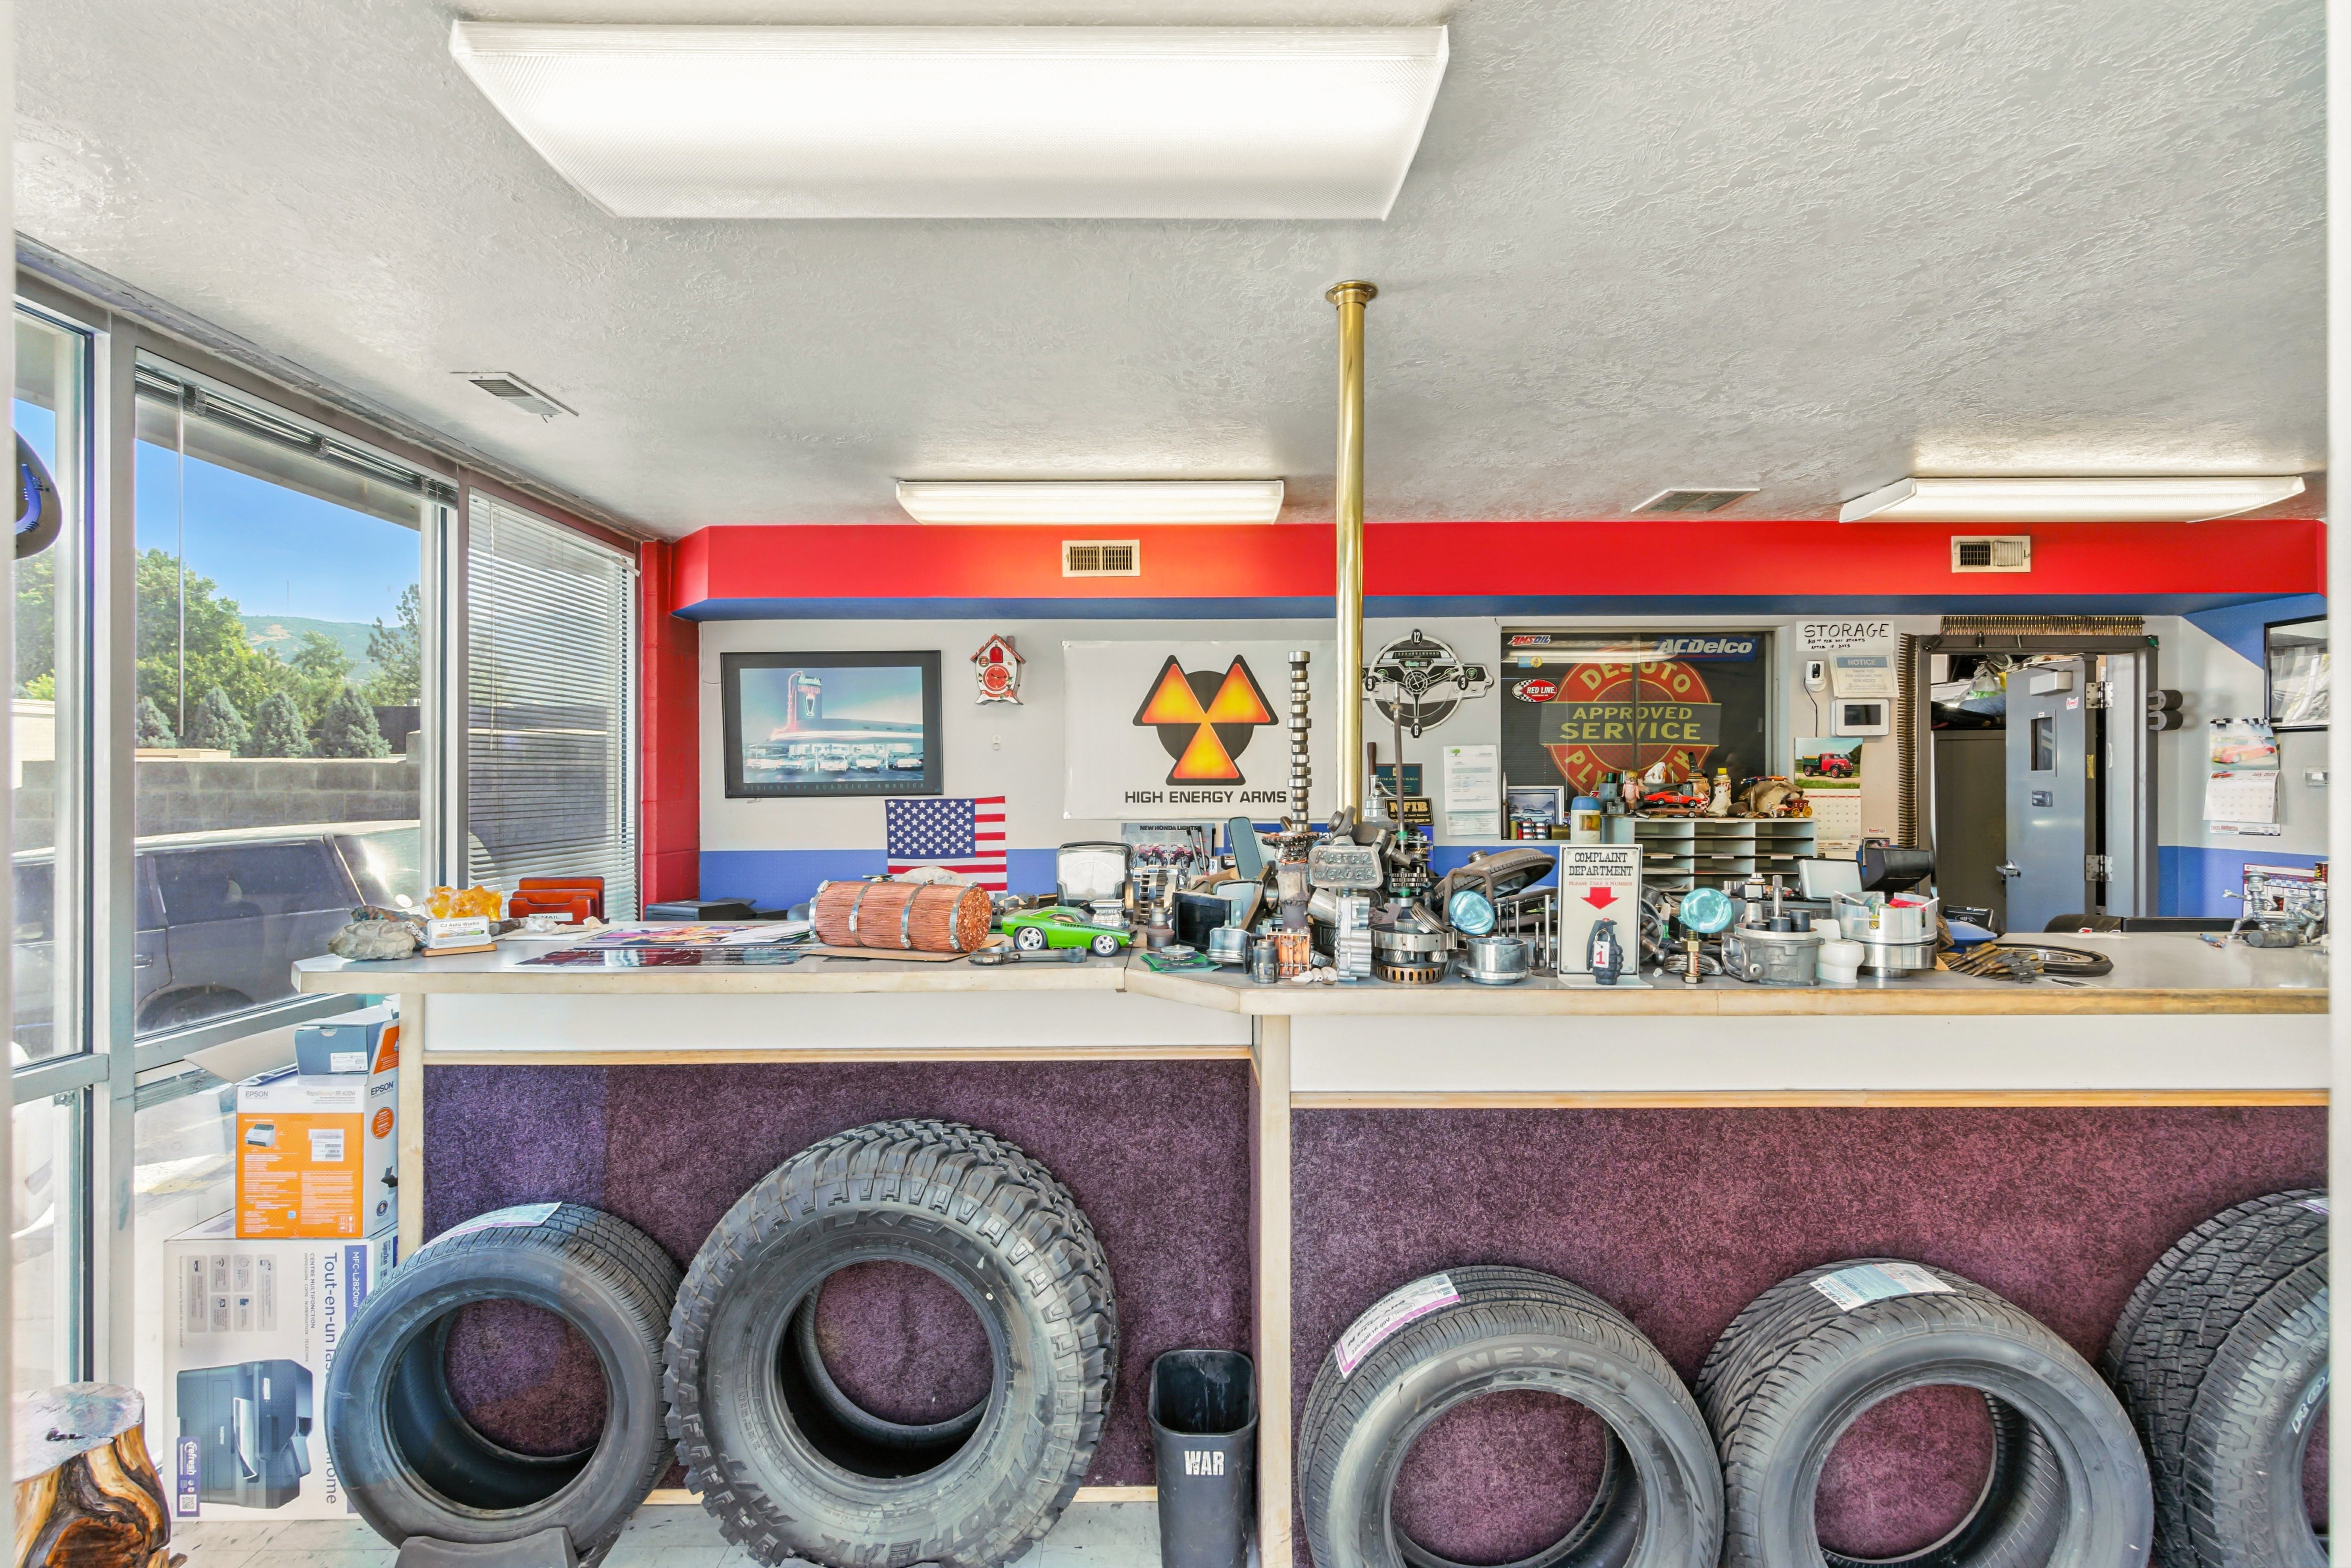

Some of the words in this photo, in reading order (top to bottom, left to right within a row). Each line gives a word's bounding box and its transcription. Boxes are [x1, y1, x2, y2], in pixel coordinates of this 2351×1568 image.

[1414, 632, 1420, 644] 12
[1804, 623, 1889, 638] STORAGE
[1510, 635, 1550, 645] AMSOIL
[1659, 638, 1753, 654] ACDelco
[1367, 678, 1373, 690] 9
[1461, 677, 1466, 688] 3
[1572, 707, 1692, 720] APPROVED
[1414, 724, 1419, 736] 6
[1559, 722, 1701, 740] SERVICE
[1564, 749, 1691, 791] PLYTH
[1125, 791, 1163, 803] HIGH
[1169, 791, 1234, 803] ENERGY
[1239, 791, 1287, 803] ARMS
[1315, 850, 1373, 865] MASTER
[1574, 852, 1628, 863] COMPLAINT
[1314, 867, 1376, 880] WELDER
[1568, 865, 1633, 876] DEPARTMENT
[1595, 950, 1606, 965] 1
[370, 1080, 394, 1096] EPSON
[758, 1209, 975, 1267] FALKEN
[324, 1252, 338, 1344] Tout-en-un
[1456, 1346, 1632, 1391] NEXEN
[187, 1445, 197, 1475] refresh
[1184, 1450, 1224, 1475] WAR
